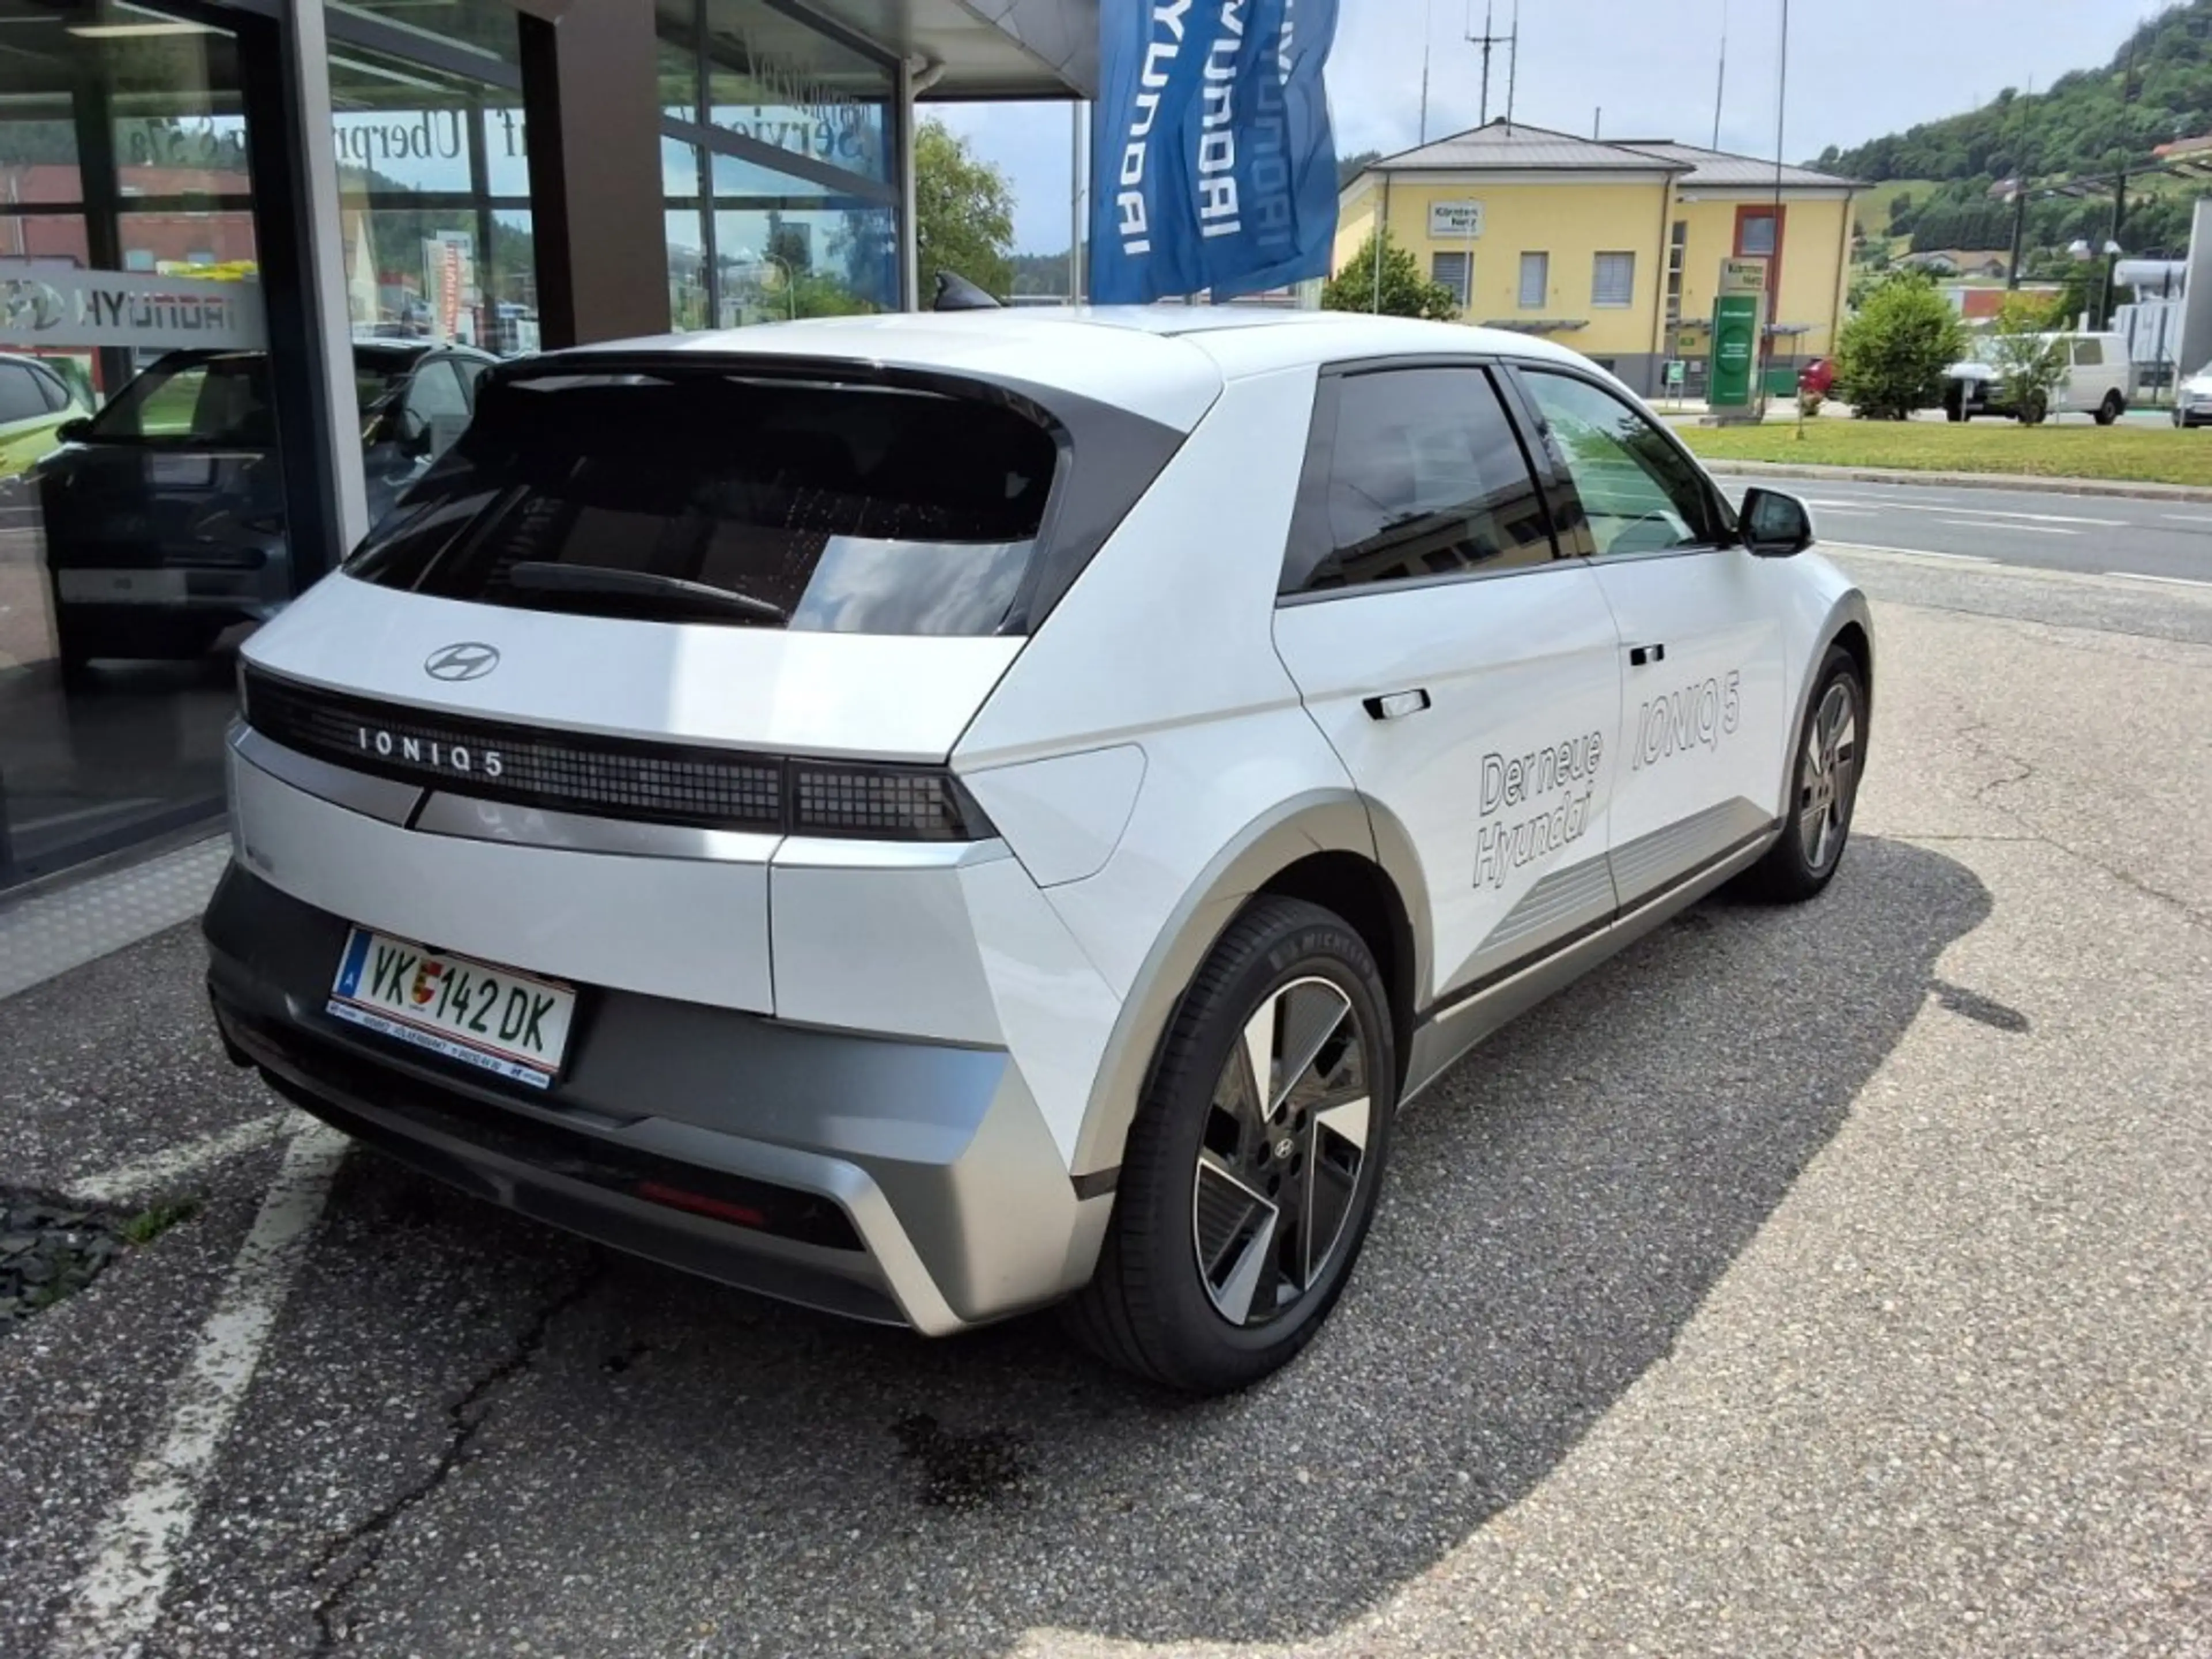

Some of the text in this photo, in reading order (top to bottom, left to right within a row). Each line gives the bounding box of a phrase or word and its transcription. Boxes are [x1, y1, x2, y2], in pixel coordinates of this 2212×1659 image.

[359, 727, 502, 777] IONIQ 5
[1632, 669, 1740, 771] IONIQ 5
[1480, 730, 1602, 817] Der neue
[1472, 779, 1593, 889] Hyundai
[372, 945, 555, 1052] VK 142 DK
